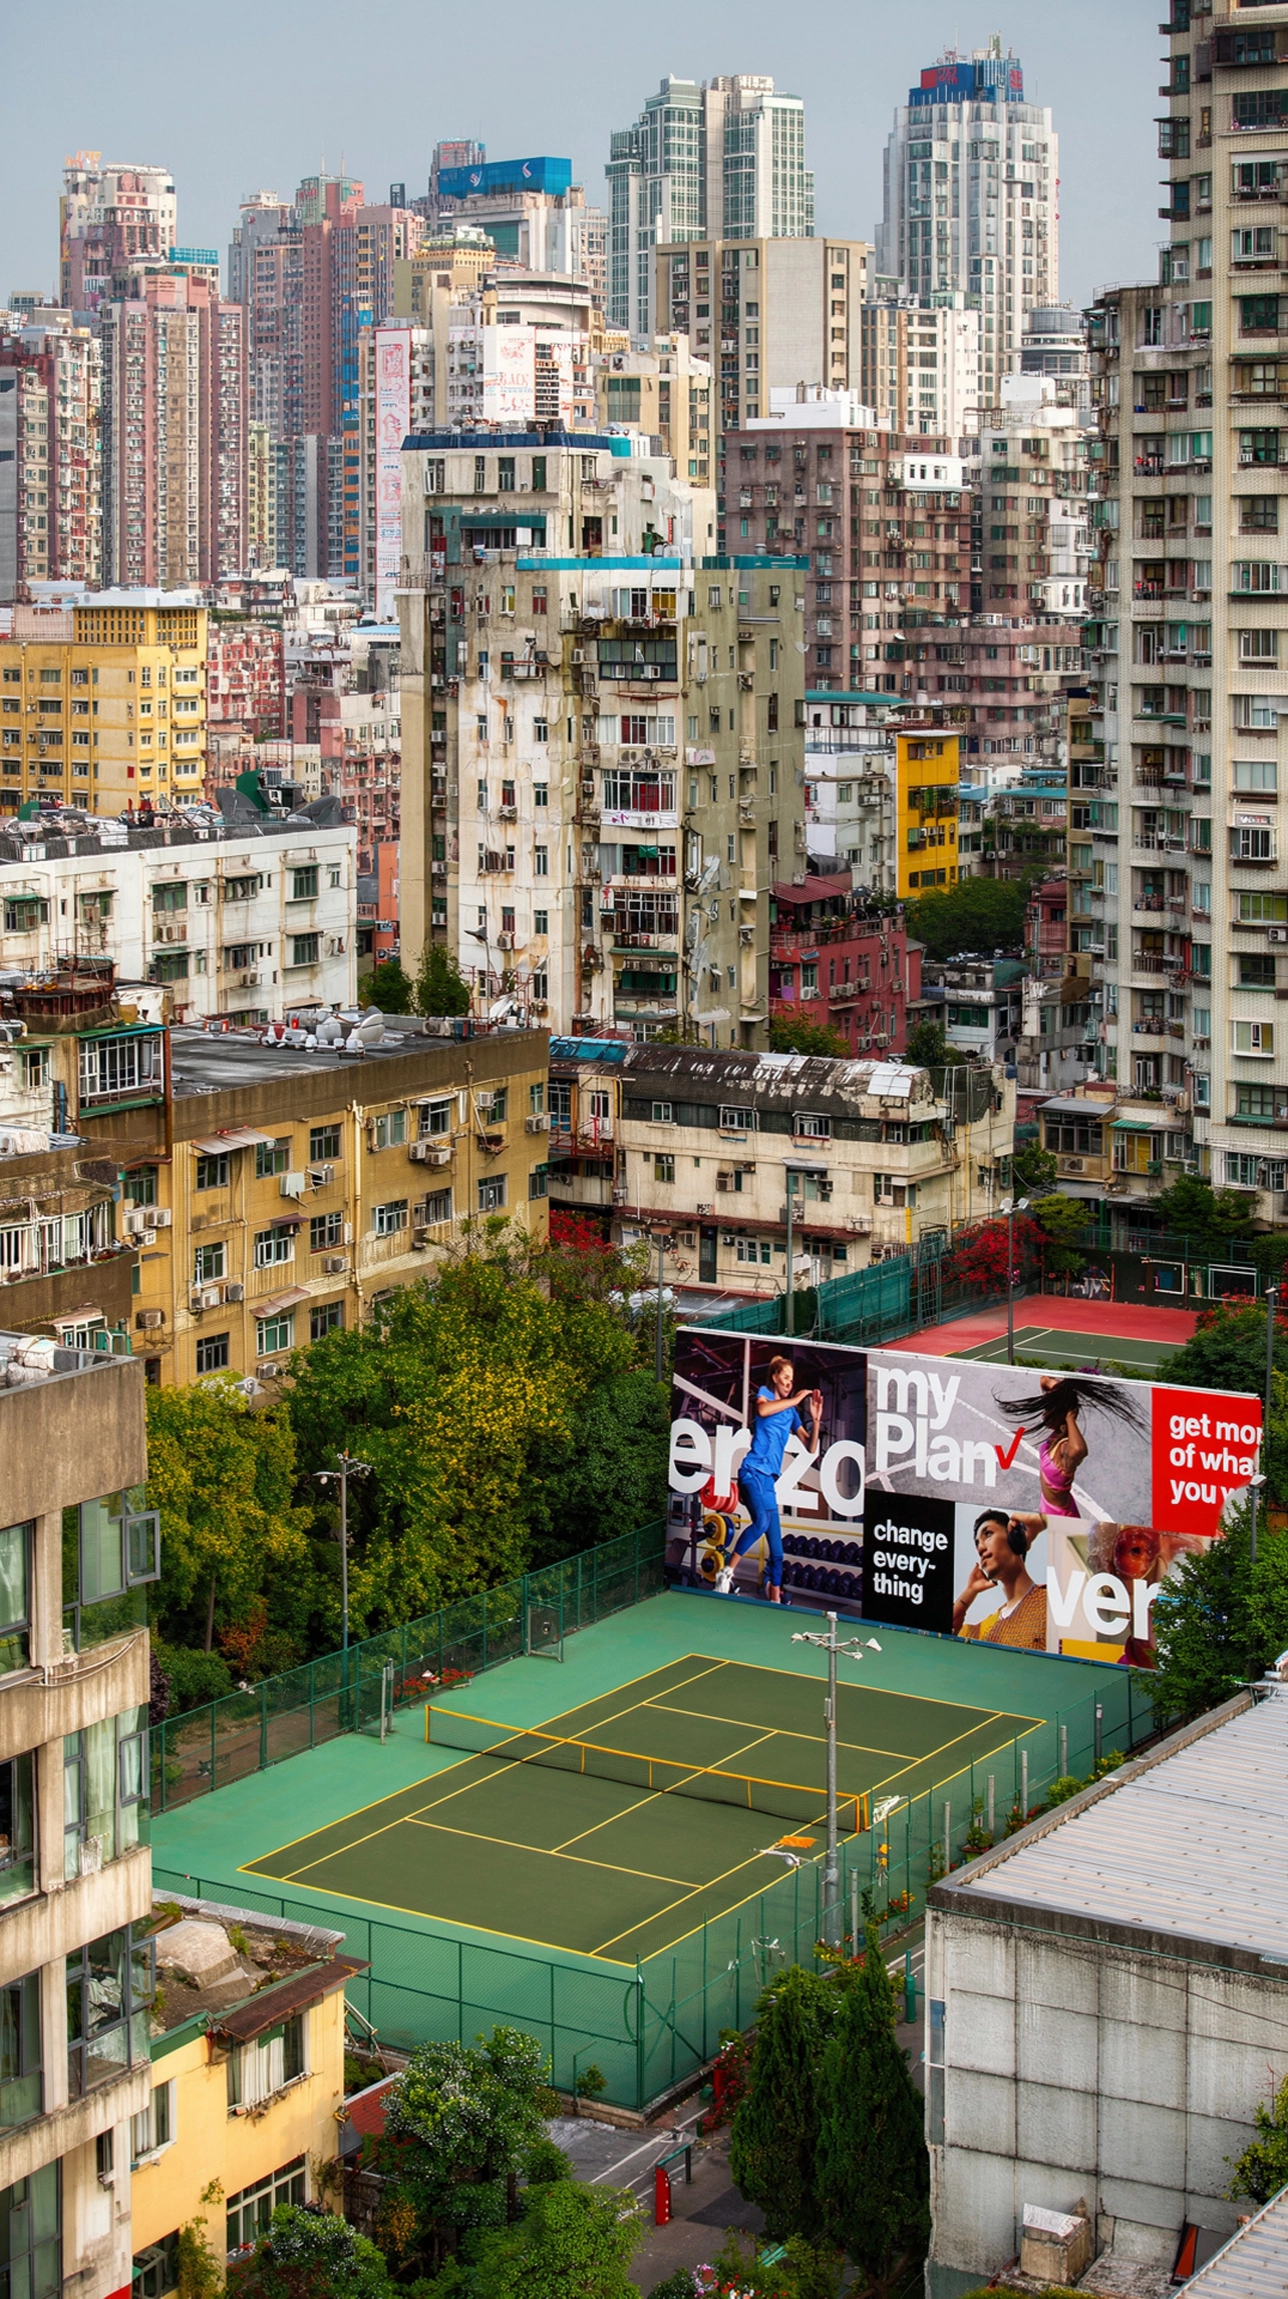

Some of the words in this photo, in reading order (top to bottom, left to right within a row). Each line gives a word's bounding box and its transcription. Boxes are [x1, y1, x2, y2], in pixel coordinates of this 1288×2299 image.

[877, 1368, 961, 1430] my
[1169, 1413, 1211, 1440] get
[876, 1412, 996, 1488] Plan
[1169, 1443, 1196, 1468] of
[1170, 1479, 1217, 1505] you
[873, 1519, 949, 1553] change
[873, 1550, 936, 1578] every-
[873, 1572, 923, 1604] thing
